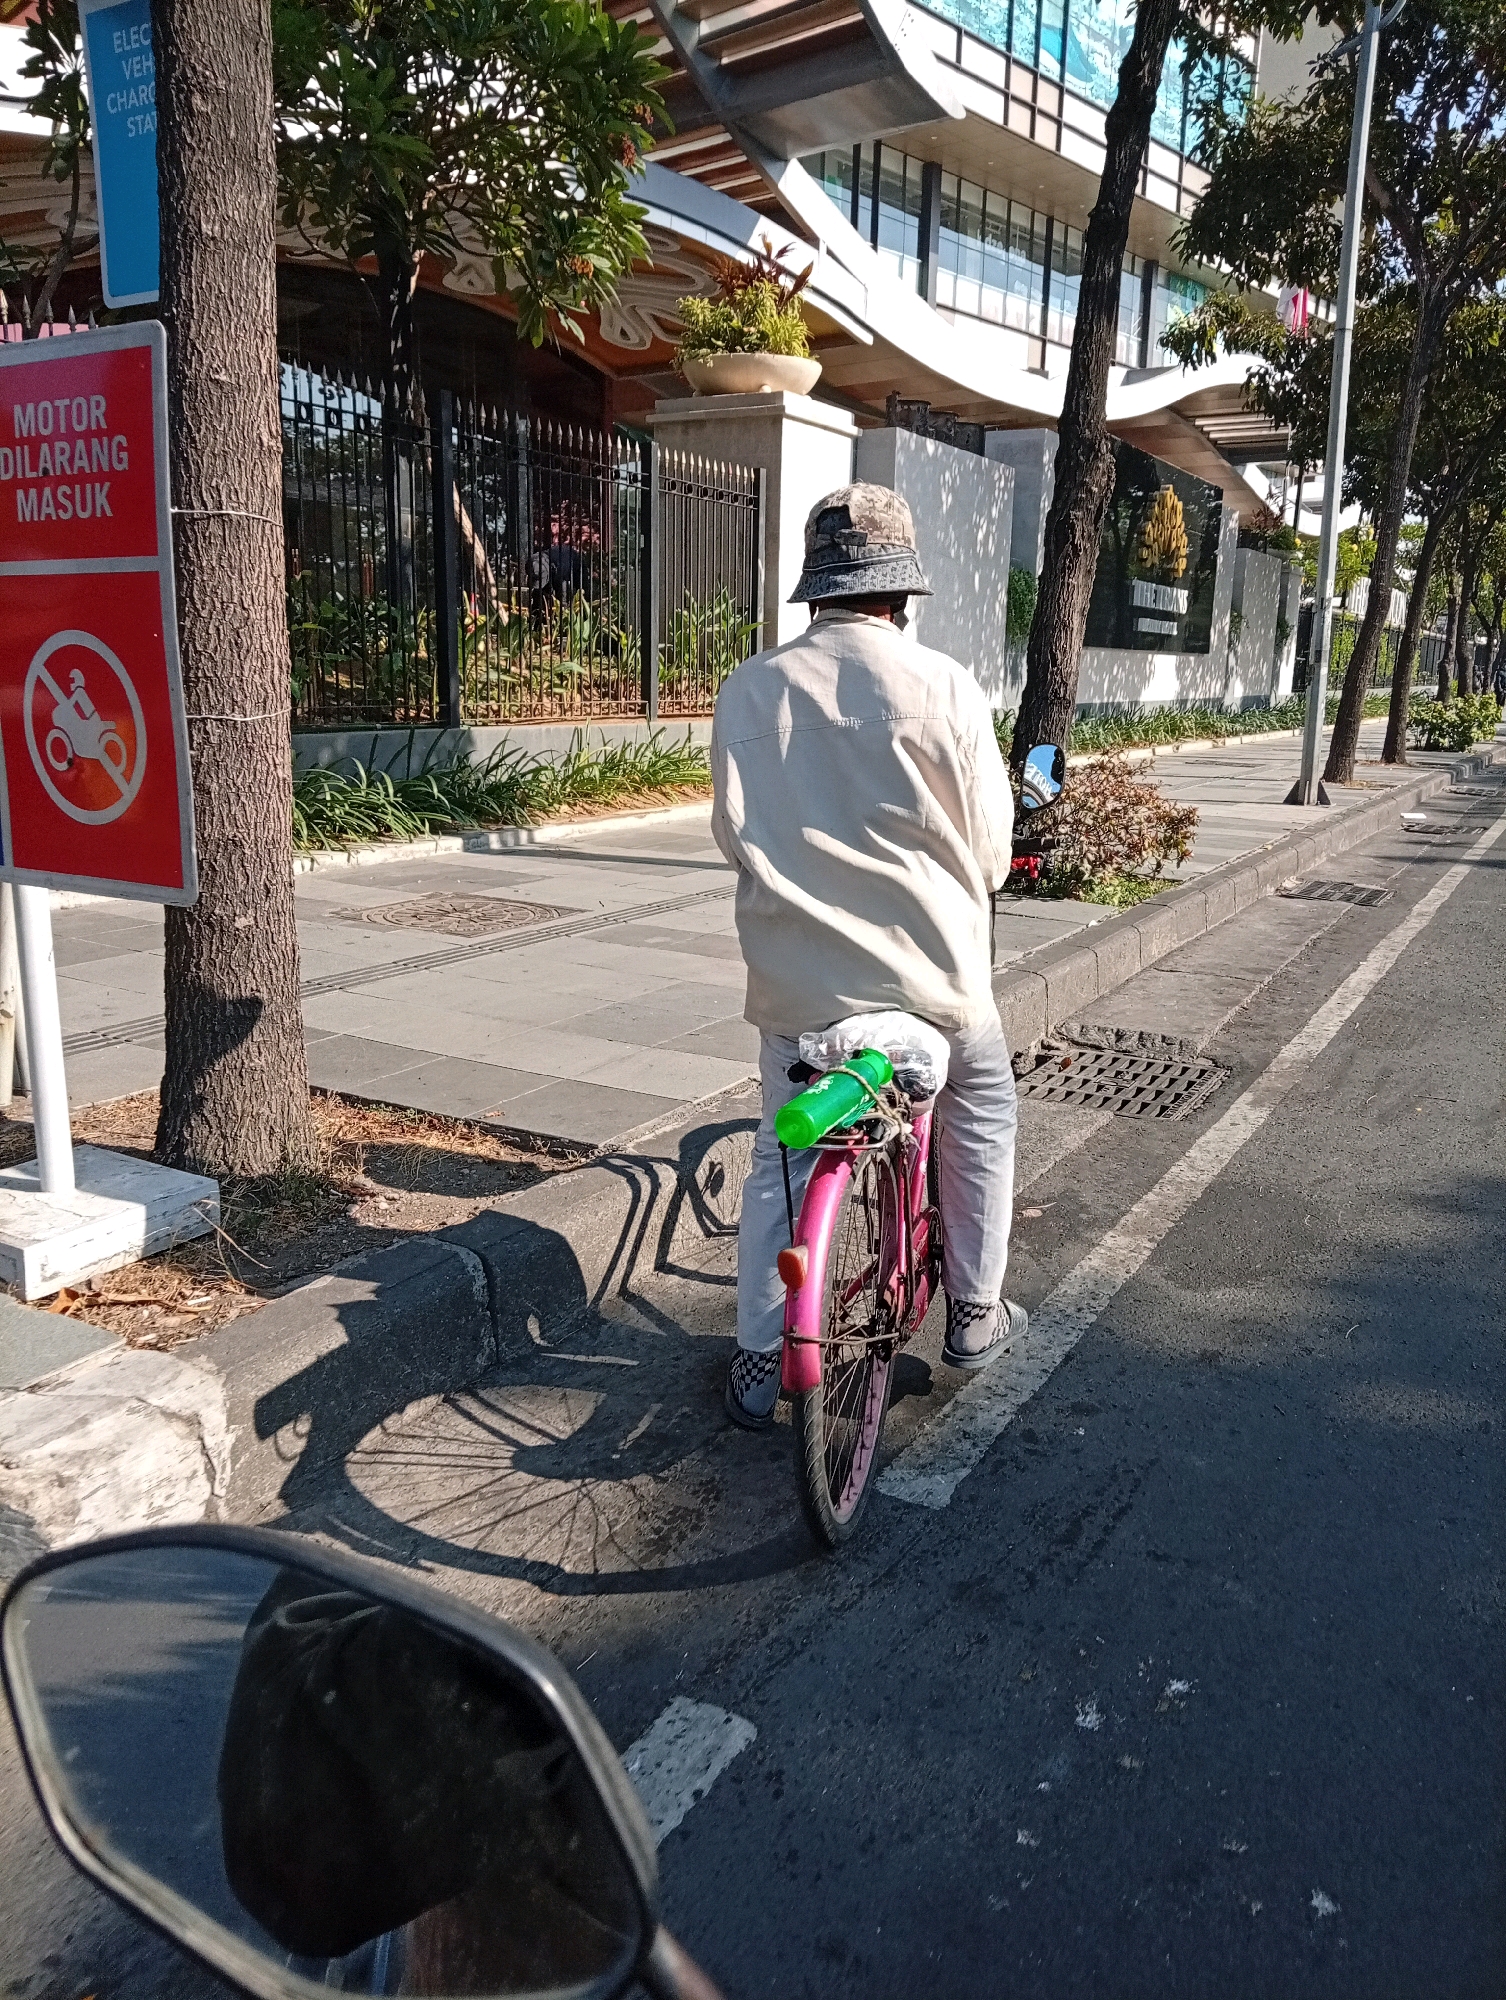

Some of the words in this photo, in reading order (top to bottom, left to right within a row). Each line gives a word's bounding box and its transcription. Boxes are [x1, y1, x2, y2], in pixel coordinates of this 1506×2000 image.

[113, 23, 152, 53] ELEC
[122, 53, 156, 80] VEH
[13, 395, 108, 438] MOTOR
[0, 435, 129, 481] DILARANG
[16, 482, 113, 522] MASUK
[1132, 578, 1156, 608] THE
